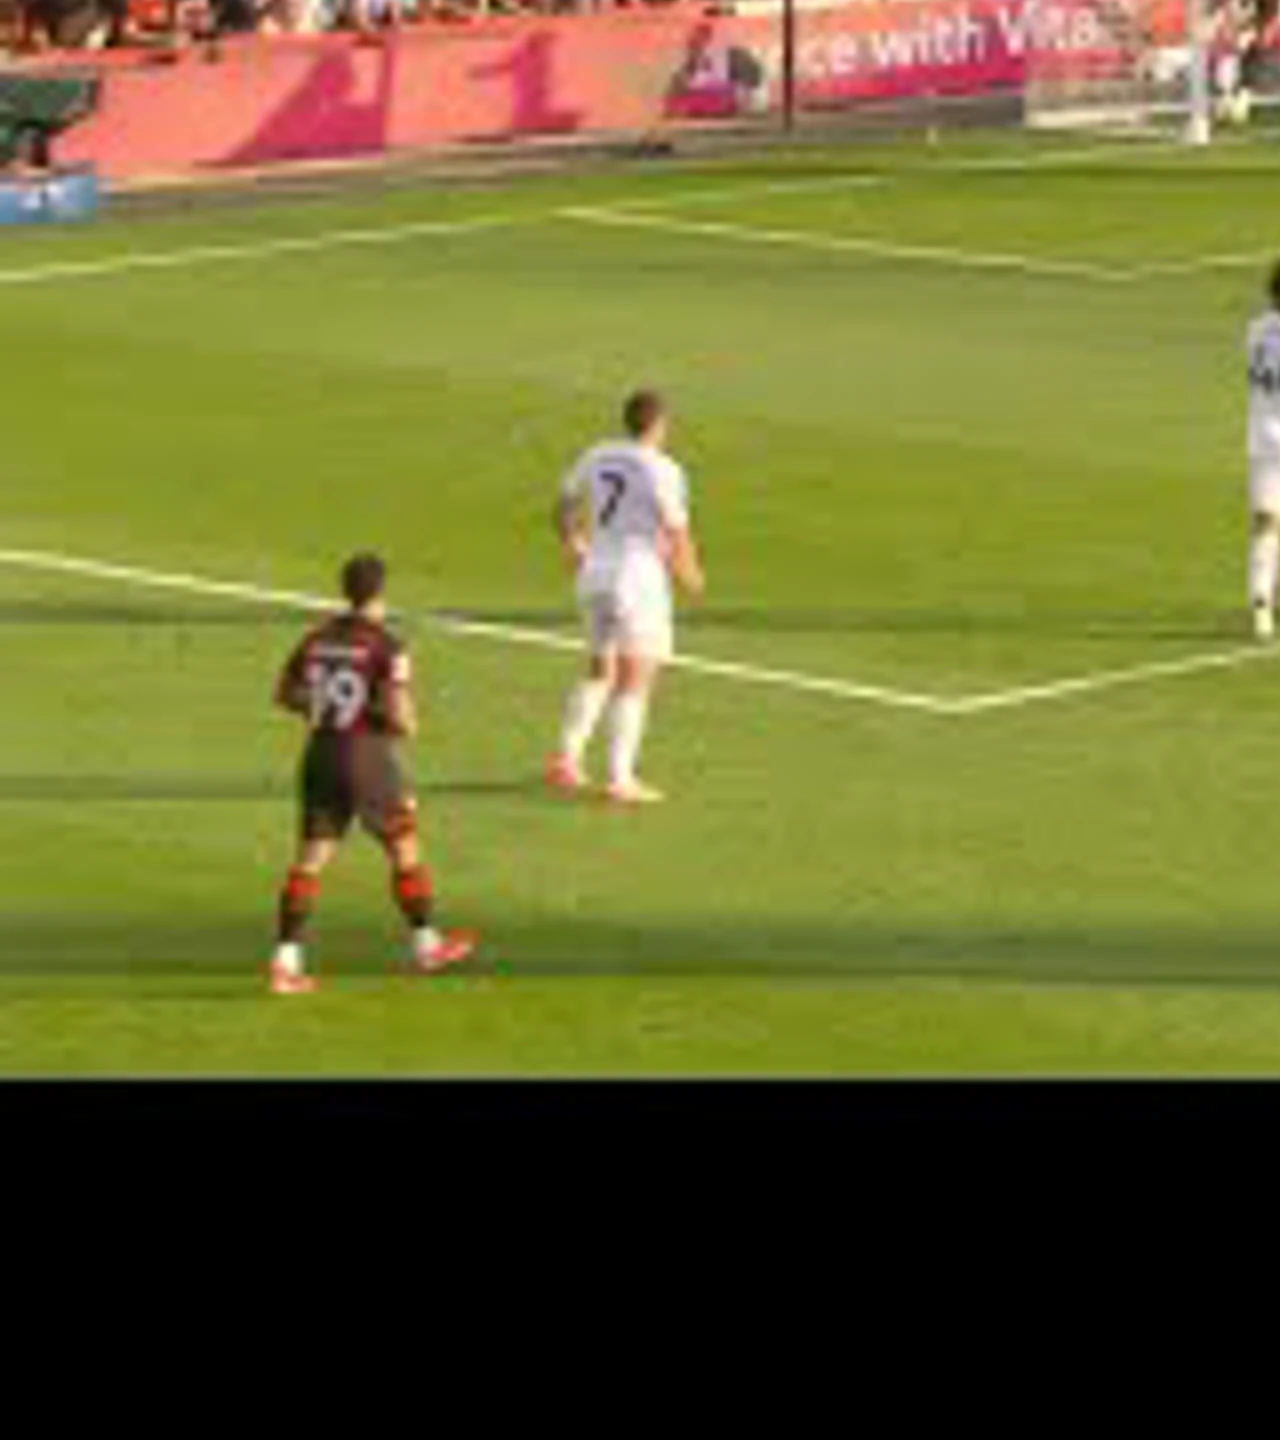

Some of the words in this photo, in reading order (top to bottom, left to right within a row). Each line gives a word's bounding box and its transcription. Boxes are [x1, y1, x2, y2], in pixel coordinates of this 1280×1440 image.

[873, 10, 987, 67] with
[598, 470, 627, 527] 7
[308, 661, 369, 729] 19
